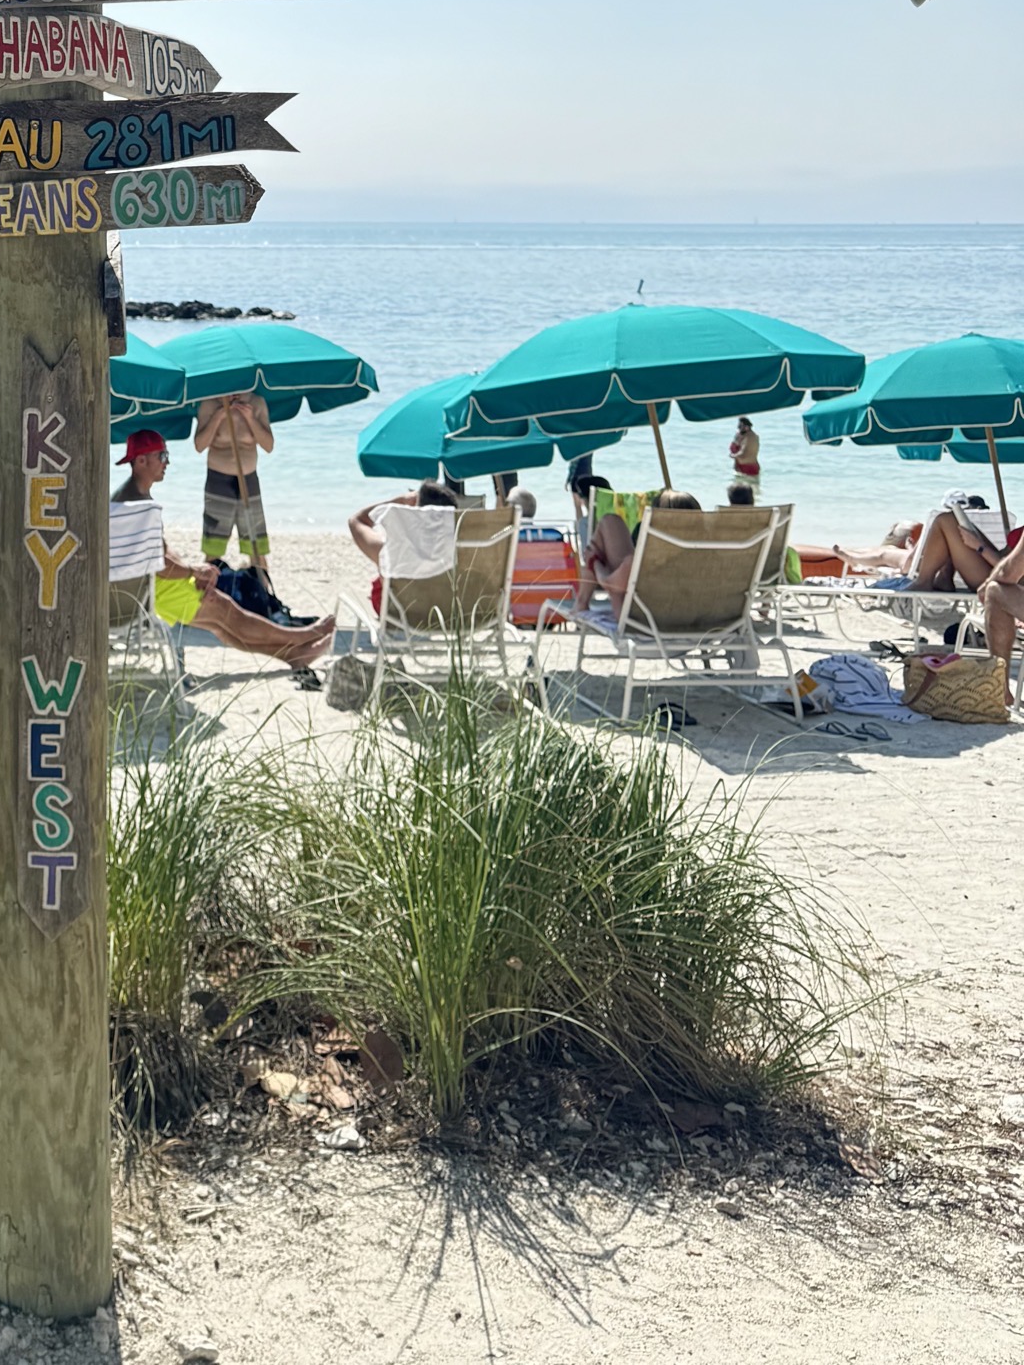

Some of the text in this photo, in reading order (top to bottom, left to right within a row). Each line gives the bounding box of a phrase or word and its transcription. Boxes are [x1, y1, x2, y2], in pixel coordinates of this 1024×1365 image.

[141, 32, 185, 94] 105
[186, 68, 207, 93] MI
[84, 110, 175, 170] 281
[179, 115, 236, 157] MI
[110, 168, 197, 228] 630
[203, 180, 245, 222] MI
[21, 407, 86, 910] KEY WEST
